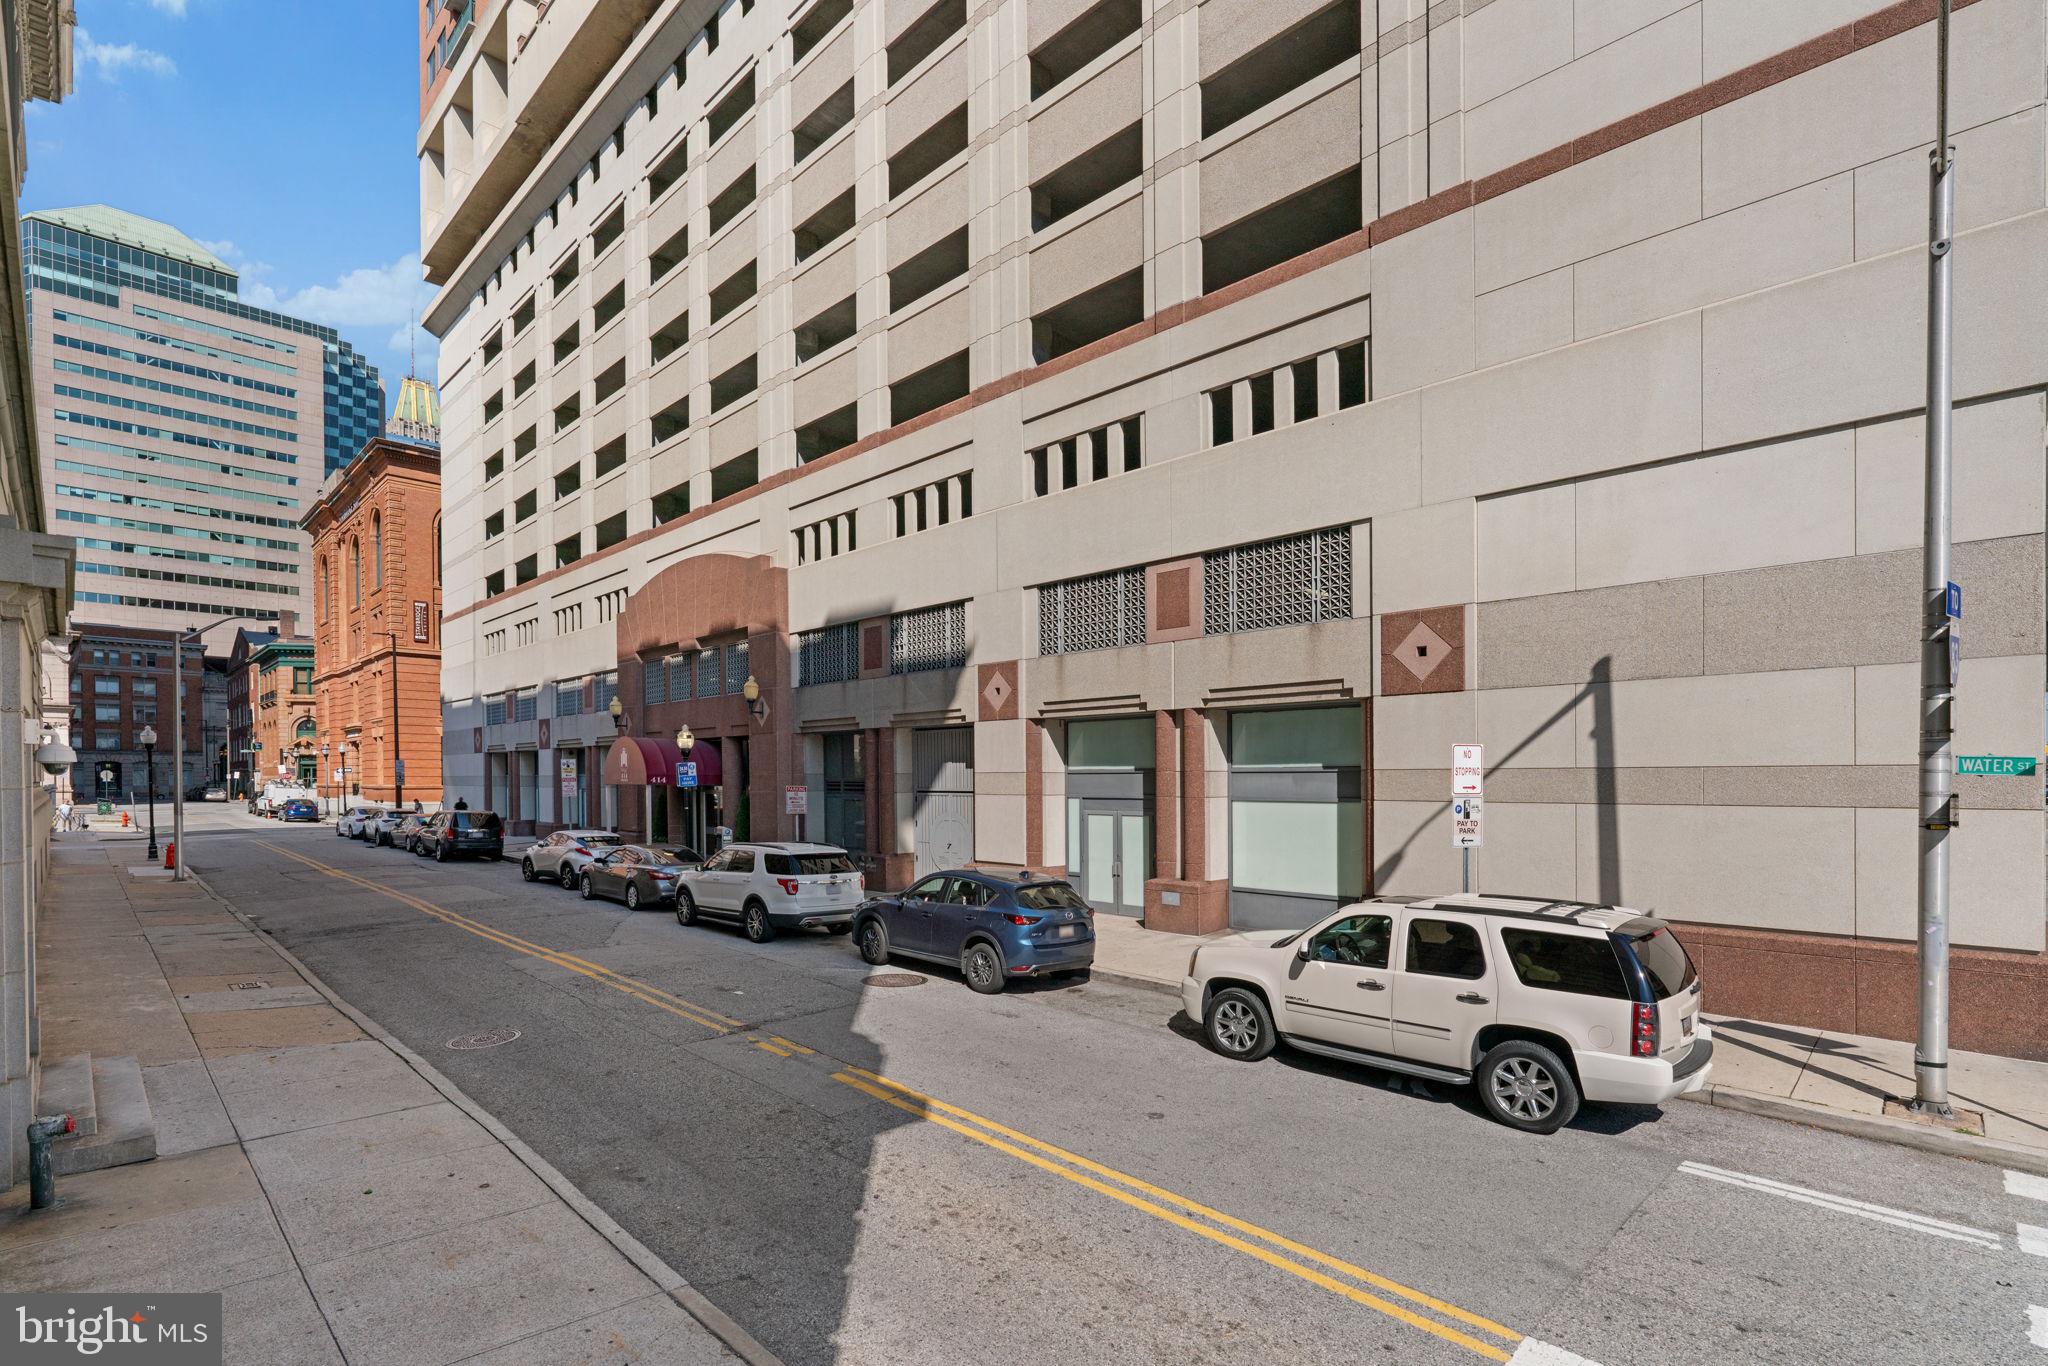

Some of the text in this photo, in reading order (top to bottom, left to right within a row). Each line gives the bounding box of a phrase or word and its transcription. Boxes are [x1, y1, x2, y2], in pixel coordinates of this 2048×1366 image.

[1951, 589, 1959, 611] TO
[1463, 750, 1472, 759] NO
[1962, 759, 2031, 772] WATER ST
[1454, 767, 1481, 776] STOPPING
[650, 776, 667, 784] 414
